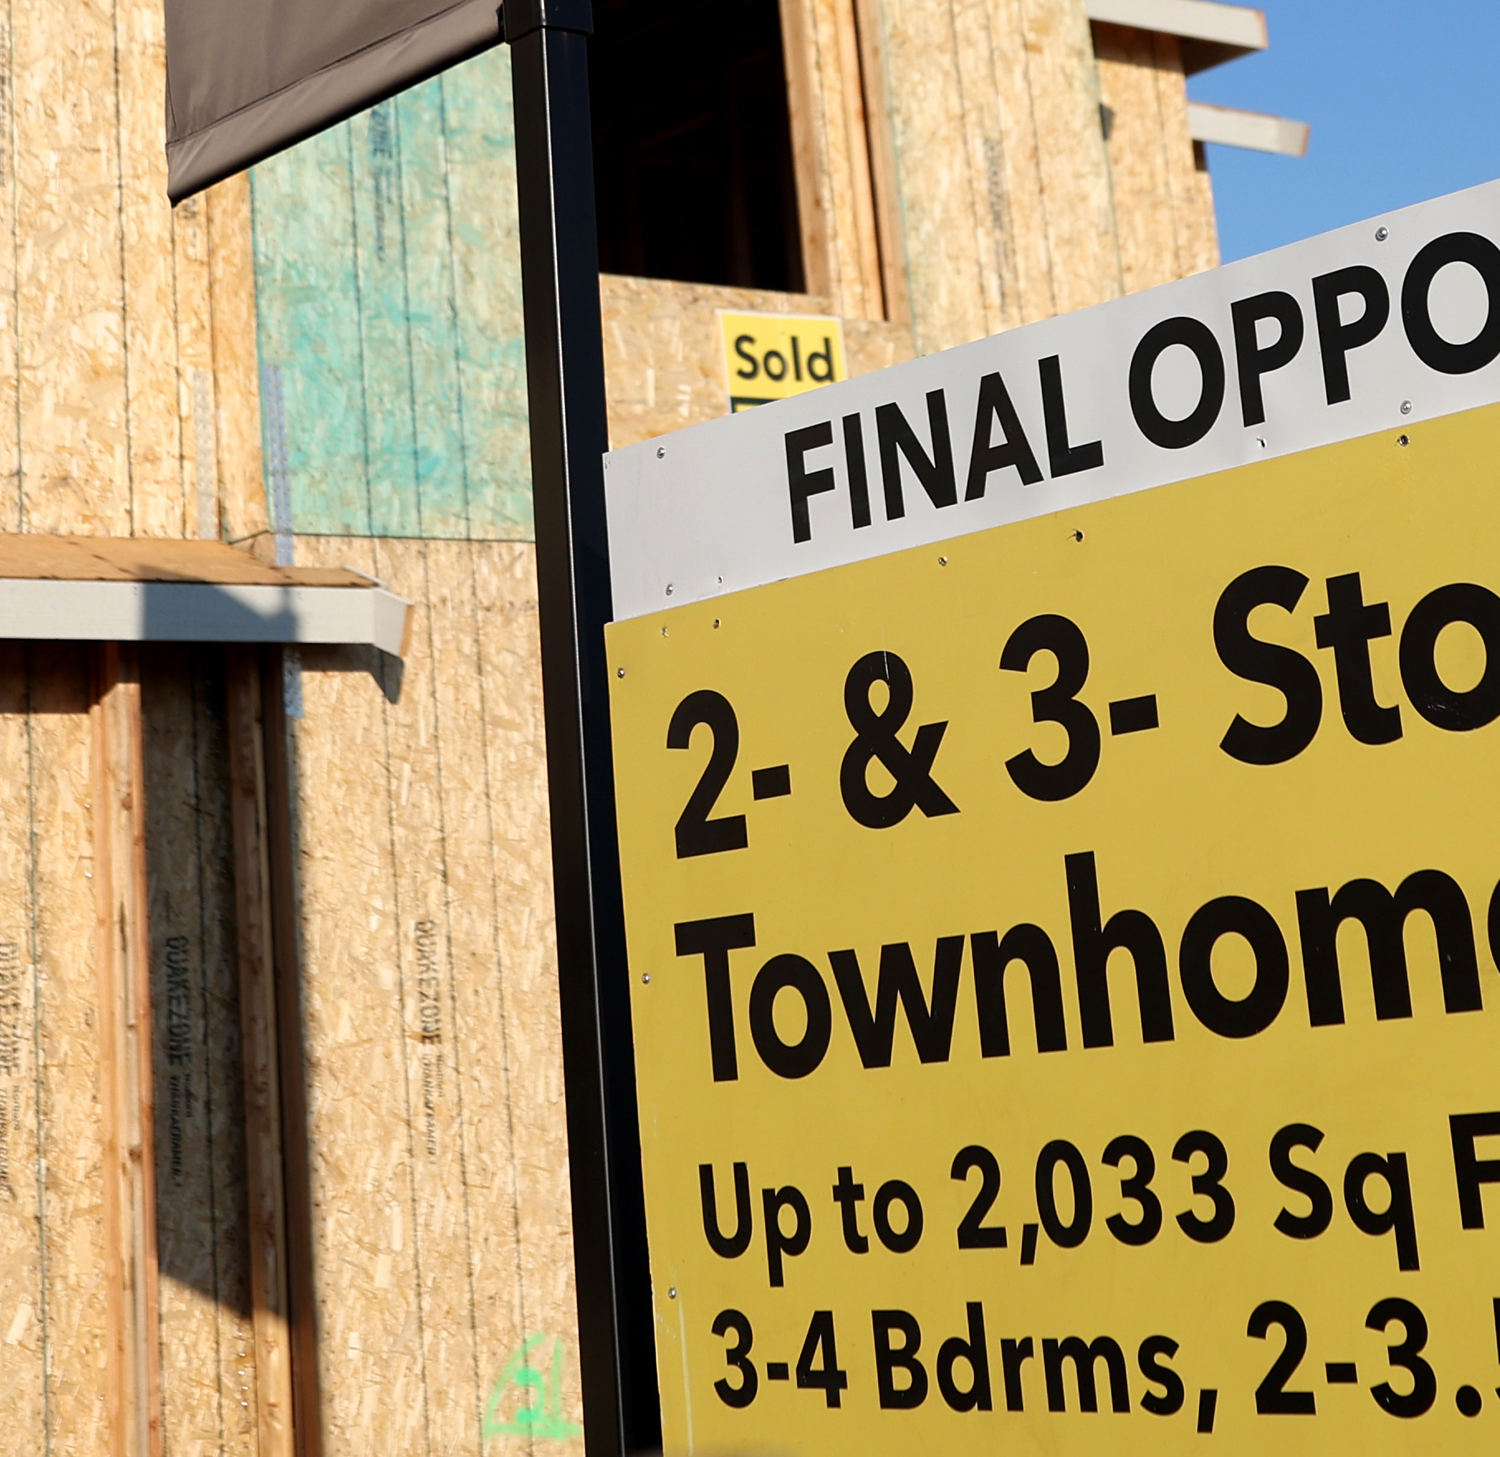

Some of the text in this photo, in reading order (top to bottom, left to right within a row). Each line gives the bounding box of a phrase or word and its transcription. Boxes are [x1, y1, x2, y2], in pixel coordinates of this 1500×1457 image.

[734, 334, 835, 383] Sold
[785, 355, 1104, 544] FINAL
[667, 689, 792, 860] 2-
[839, 650, 961, 829] &
[999, 613, 1160, 802] 3-
[165, 935, 193, 1067] QUAKEZONE
[414, 919, 443, 1046] QUAKEZONE
[698, 1161, 812, 1288] Up
[832, 1166, 924, 1254] to
[950, 1130, 1236, 1266] 2,033
[1269, 1123, 1420, 1272] Sq
[711, 1309, 848, 1410] 3-4
[871, 1301, 1218, 1434] Bdrms,
